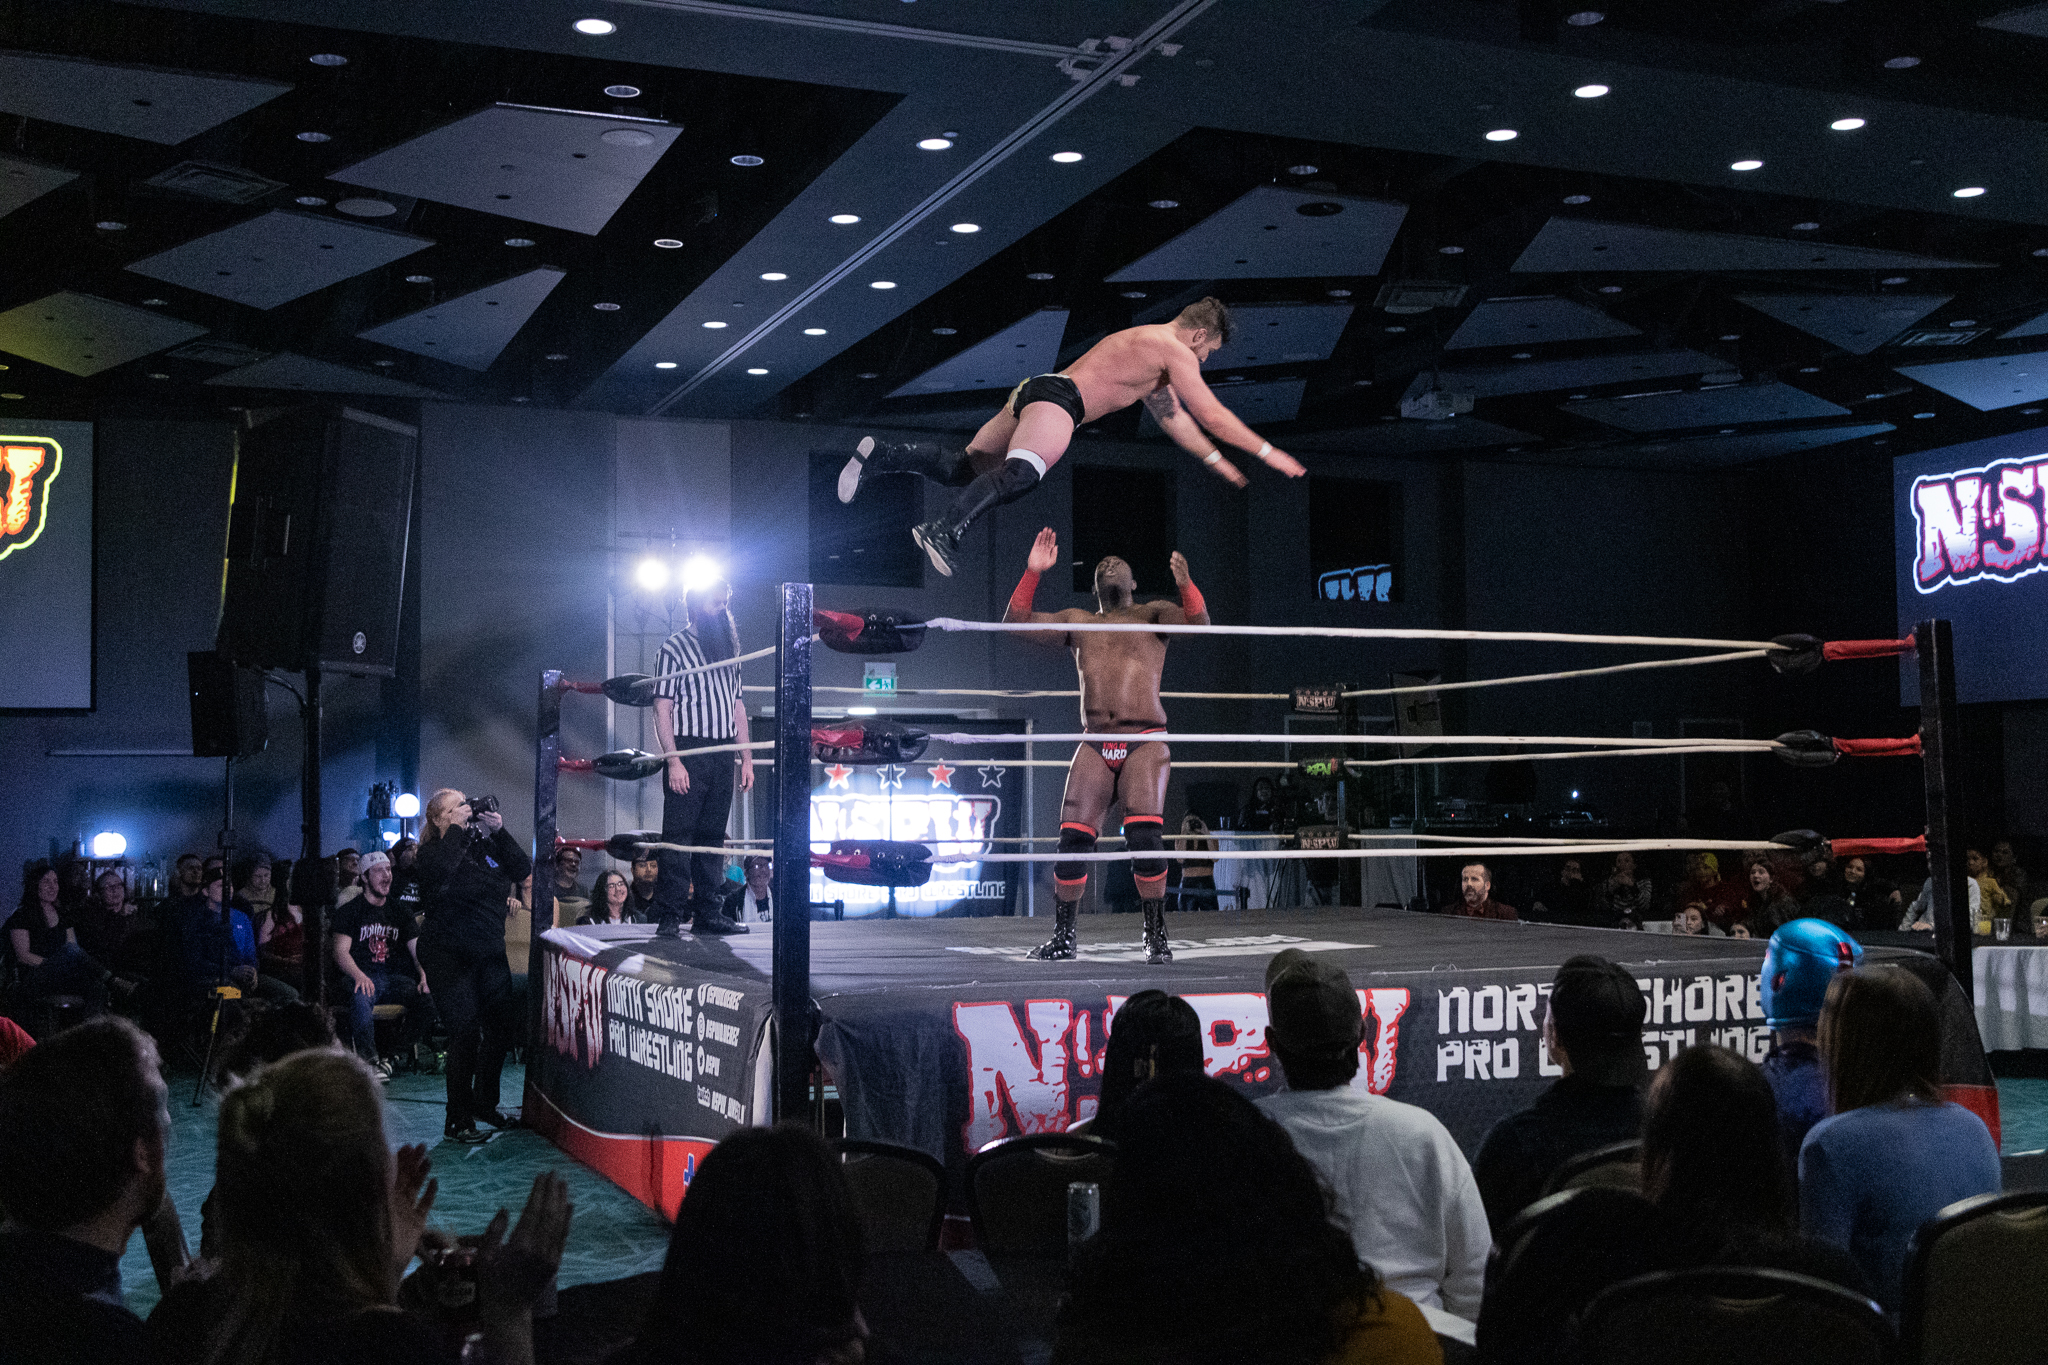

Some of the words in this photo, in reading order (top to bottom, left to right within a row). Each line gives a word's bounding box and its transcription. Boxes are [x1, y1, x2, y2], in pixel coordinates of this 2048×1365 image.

[1102, 749, 1127, 760] HARD
[922, 881, 1005, 899] WRESTLING
[606, 973, 645, 1022] NORTH
[645, 983, 694, 1034] SHORE
[608, 1019, 627, 1058] PRO
[629, 1025, 693, 1082] WRESTLING
[1437, 1038, 1520, 1082] PRO
